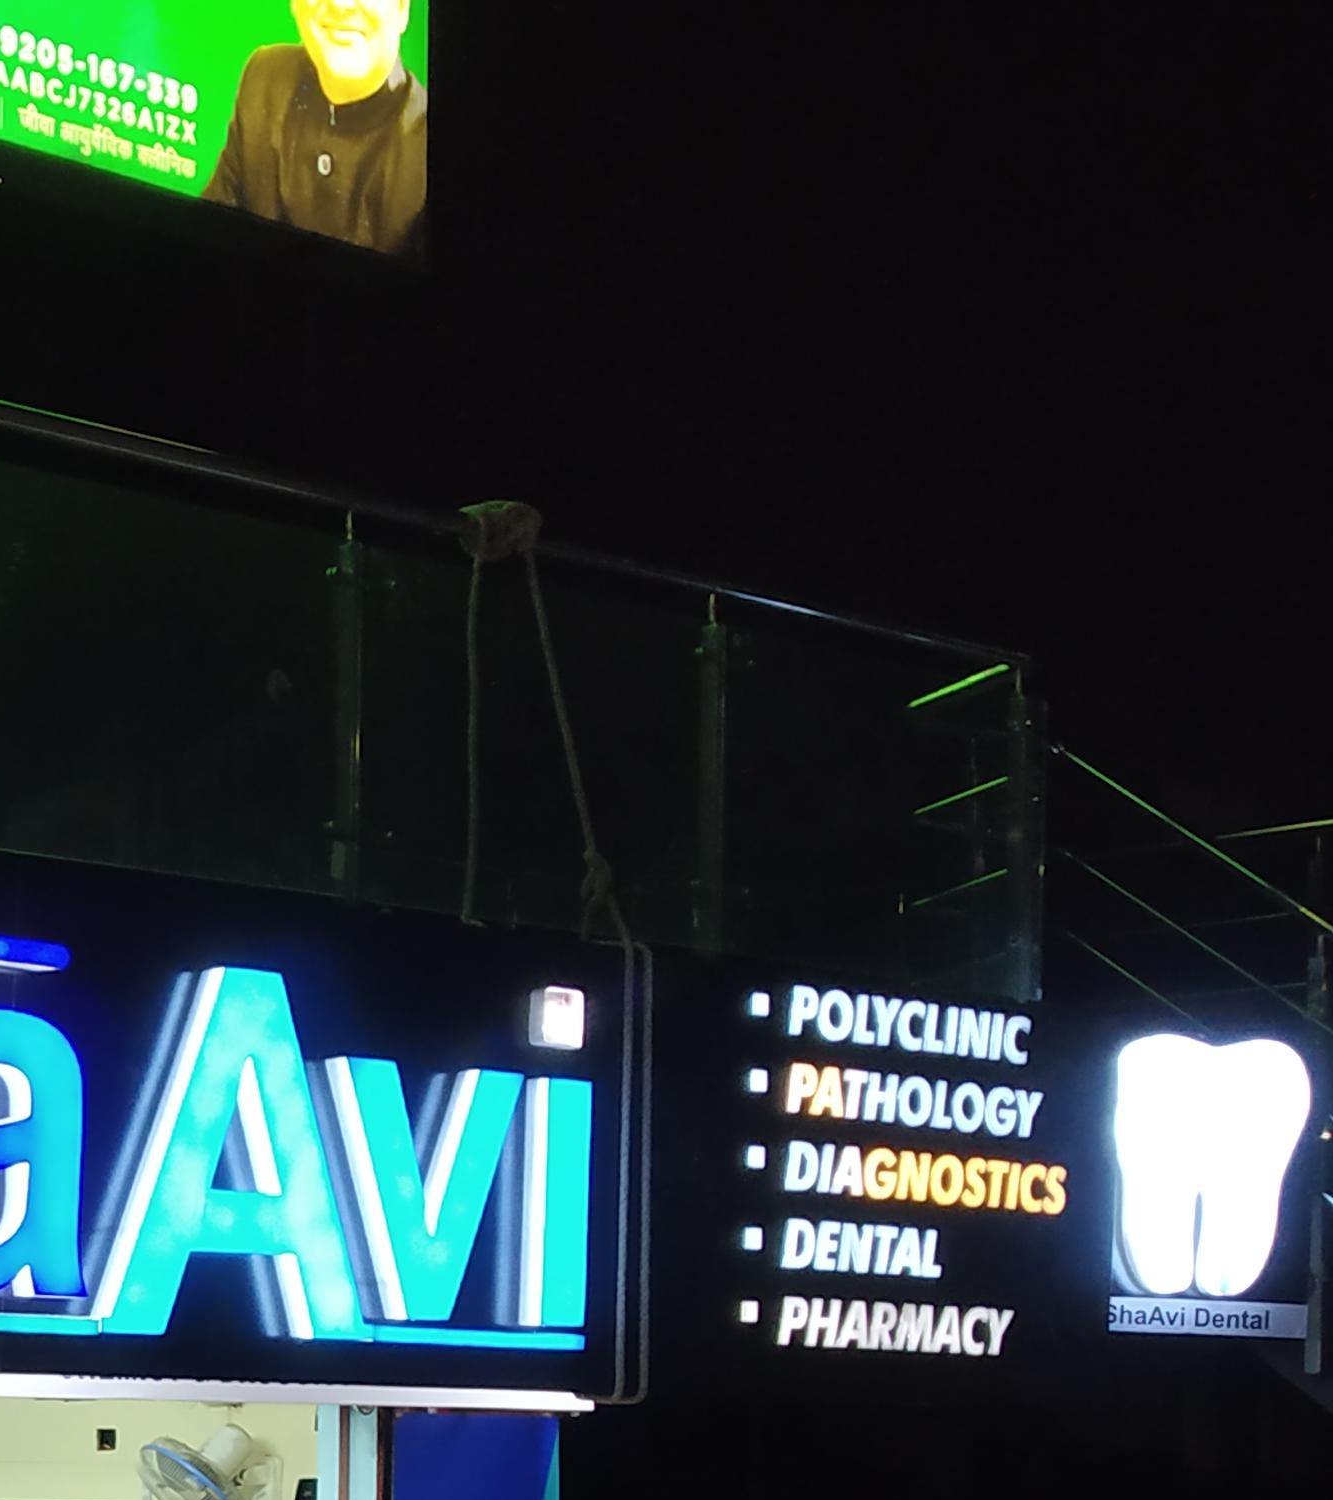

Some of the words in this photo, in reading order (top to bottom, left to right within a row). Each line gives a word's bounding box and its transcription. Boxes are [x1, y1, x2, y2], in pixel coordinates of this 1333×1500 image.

[786, 983, 1033, 1066] POLYCLINIC
[785, 1062, 1043, 1140] PATHOLOGY
[783, 1139, 1068, 1216] DIAGNOSTICS
[779, 1217, 942, 1279] DENTAL
[775, 1295, 1015, 1357] PHARMACY
[1108, 1303, 1185, 1327] ShaAvi
[1194, 1307, 1271, 1330] Dental
